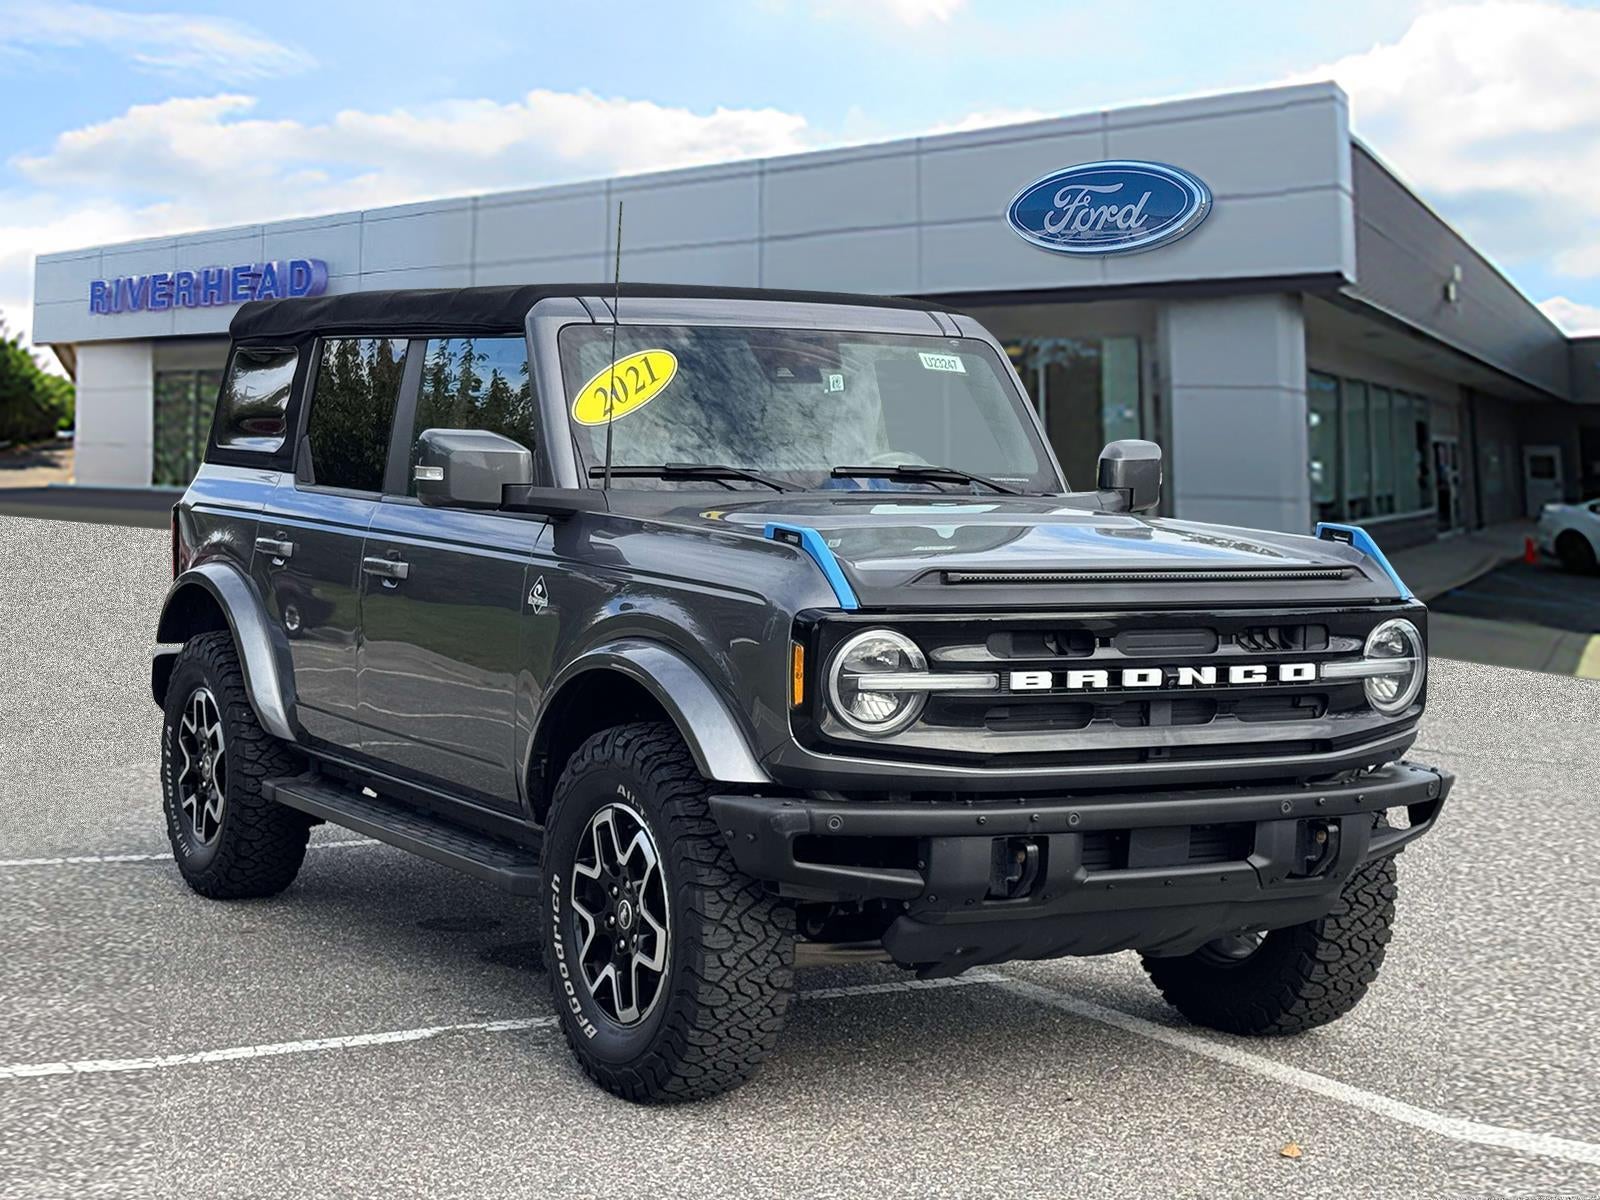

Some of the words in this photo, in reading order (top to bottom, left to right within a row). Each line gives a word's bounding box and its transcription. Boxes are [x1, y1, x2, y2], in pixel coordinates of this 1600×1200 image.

[1044, 183, 1151, 234] Ford
[89, 258, 327, 315] RIVERHEAD
[594, 356, 660, 417] 2021
[924, 356, 958, 370] U23247
[1010, 663, 1315, 690] BRONCO
[551, 874, 598, 1039] BFGoodrich
